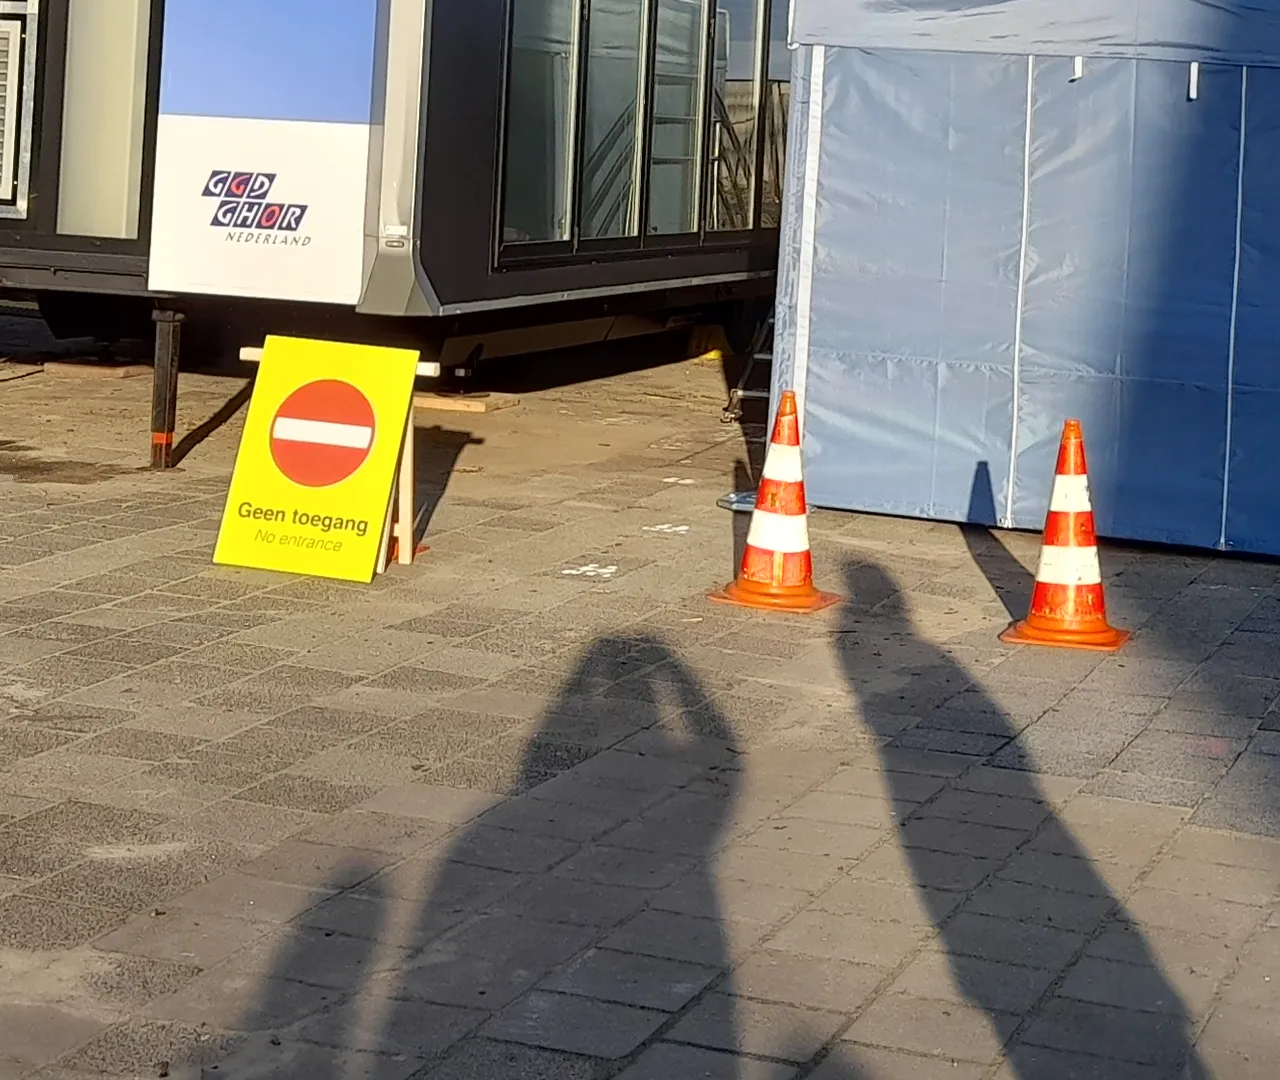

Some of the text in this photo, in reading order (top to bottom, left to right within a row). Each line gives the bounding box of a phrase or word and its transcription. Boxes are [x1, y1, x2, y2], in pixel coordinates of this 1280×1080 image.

[206, 172, 272, 197] GGD
[215, 202, 303, 229] GHOR
[225, 231, 311, 247] NEDERLAND
[238, 502, 368, 536] Geen toegang
[254, 529, 343, 552] No entrance
